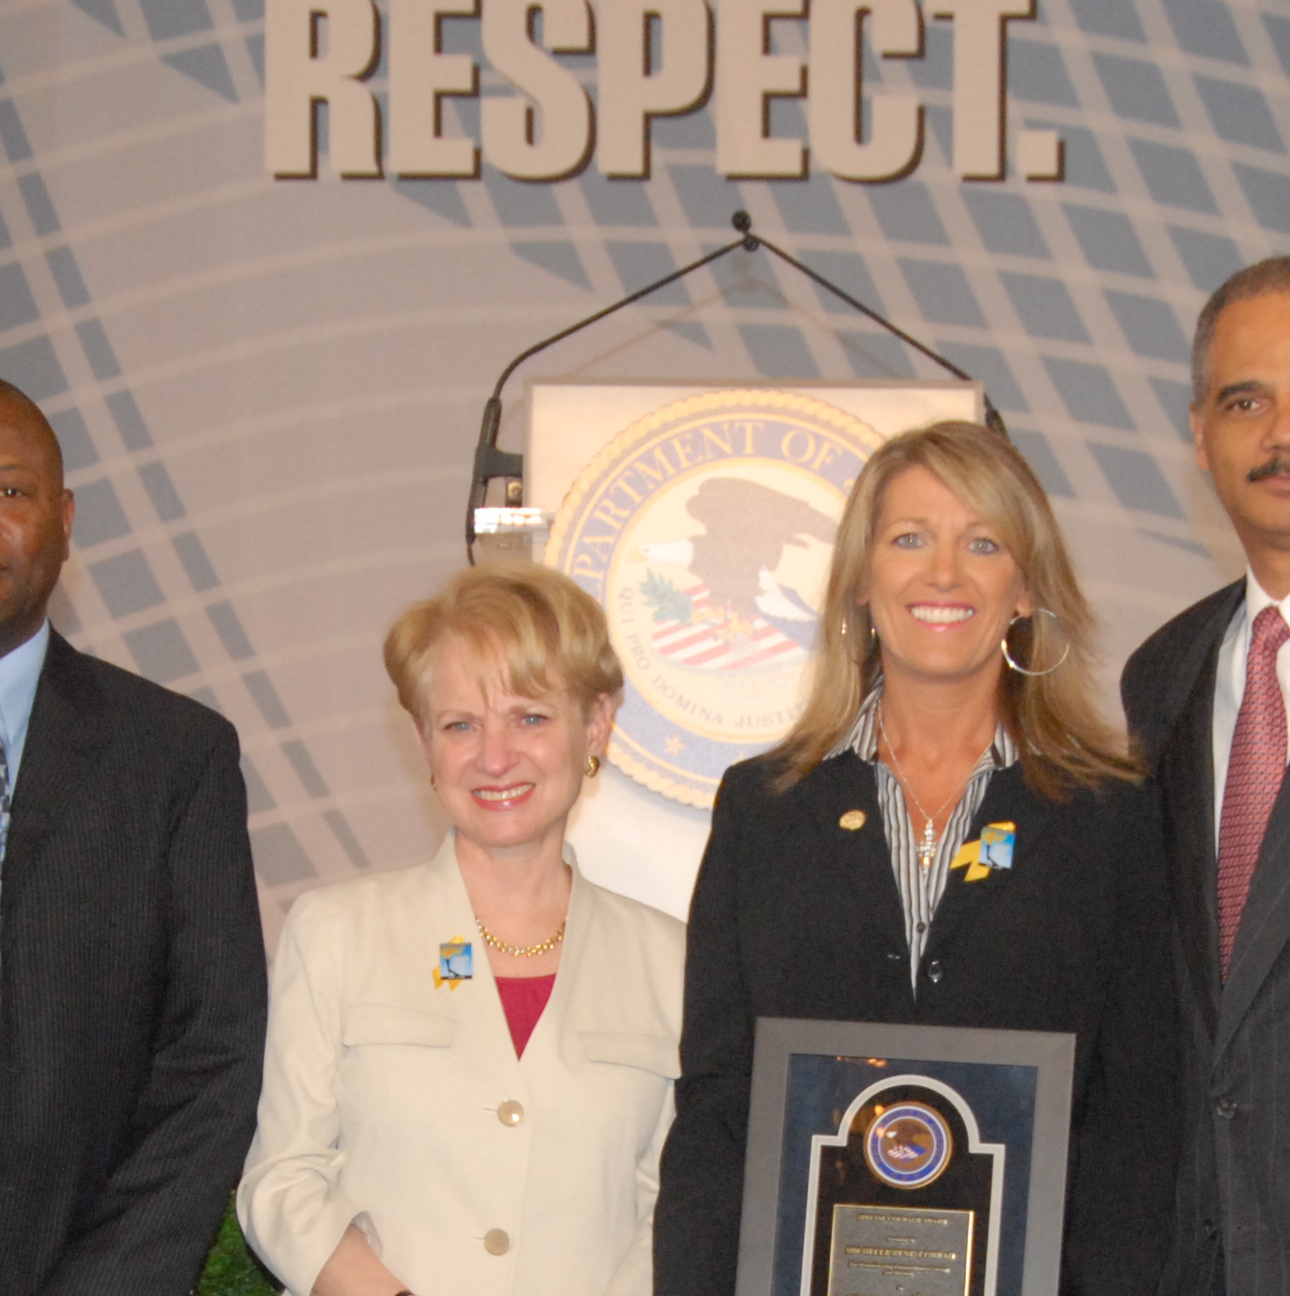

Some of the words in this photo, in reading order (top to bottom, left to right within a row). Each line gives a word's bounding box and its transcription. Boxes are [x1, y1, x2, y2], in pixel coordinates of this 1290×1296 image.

[265, 0, 1064, 182] RESPECT.
[573, 421, 764, 602] PARTMENT
[780, 428, 843, 471] OF
[651, 674, 724, 727] DOMINA
